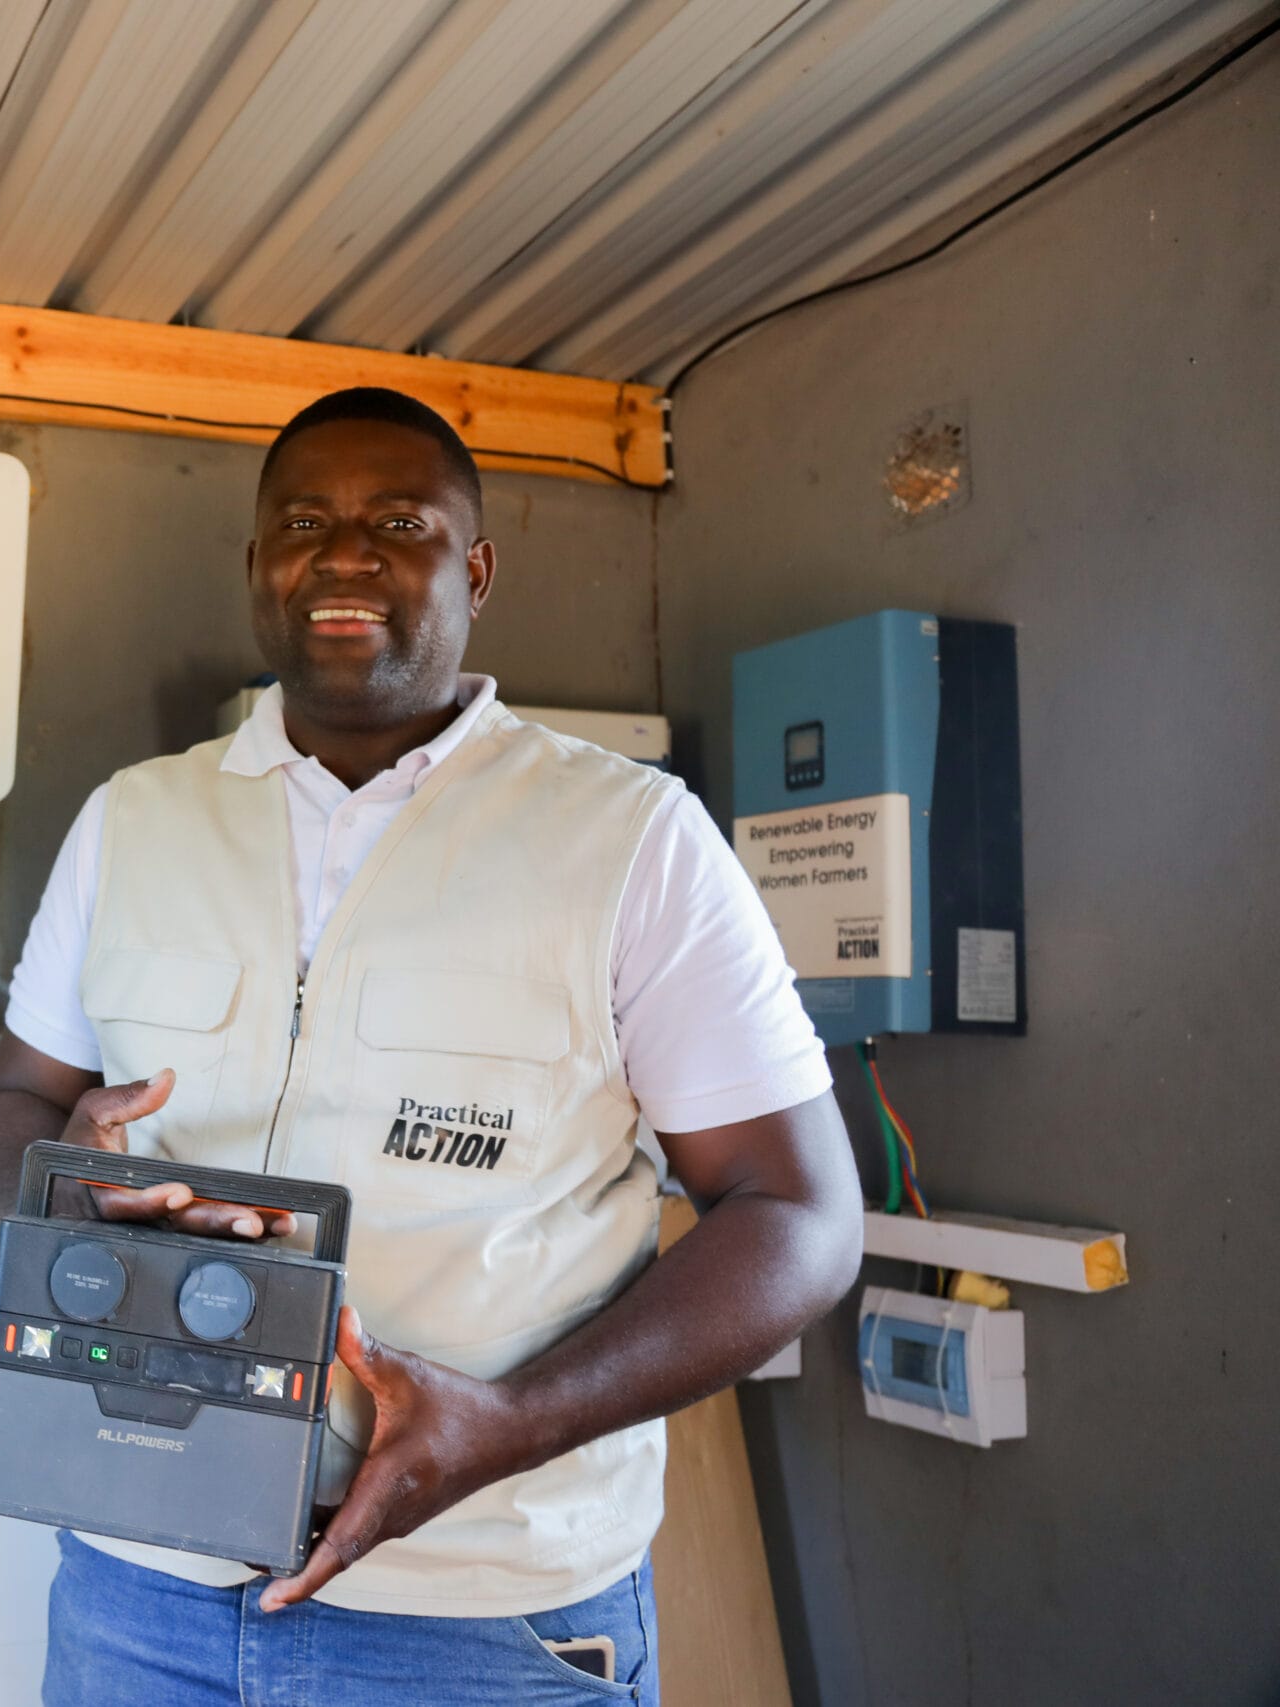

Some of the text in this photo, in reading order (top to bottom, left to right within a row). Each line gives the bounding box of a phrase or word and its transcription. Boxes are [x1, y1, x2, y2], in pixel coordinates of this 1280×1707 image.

[750, 811, 877, 840] Renewable Energy
[769, 841, 855, 864] Empowering
[759, 866, 868, 889] Women Farmers
[837, 923, 880, 936] Practical
[836, 939, 880, 960] ACTION
[398, 1096, 514, 1131] Practical
[382, 1117, 508, 1171] ACTION
[90, 1346, 108, 1361] DC
[96, 1428, 186, 1453] ALLPOWERS
